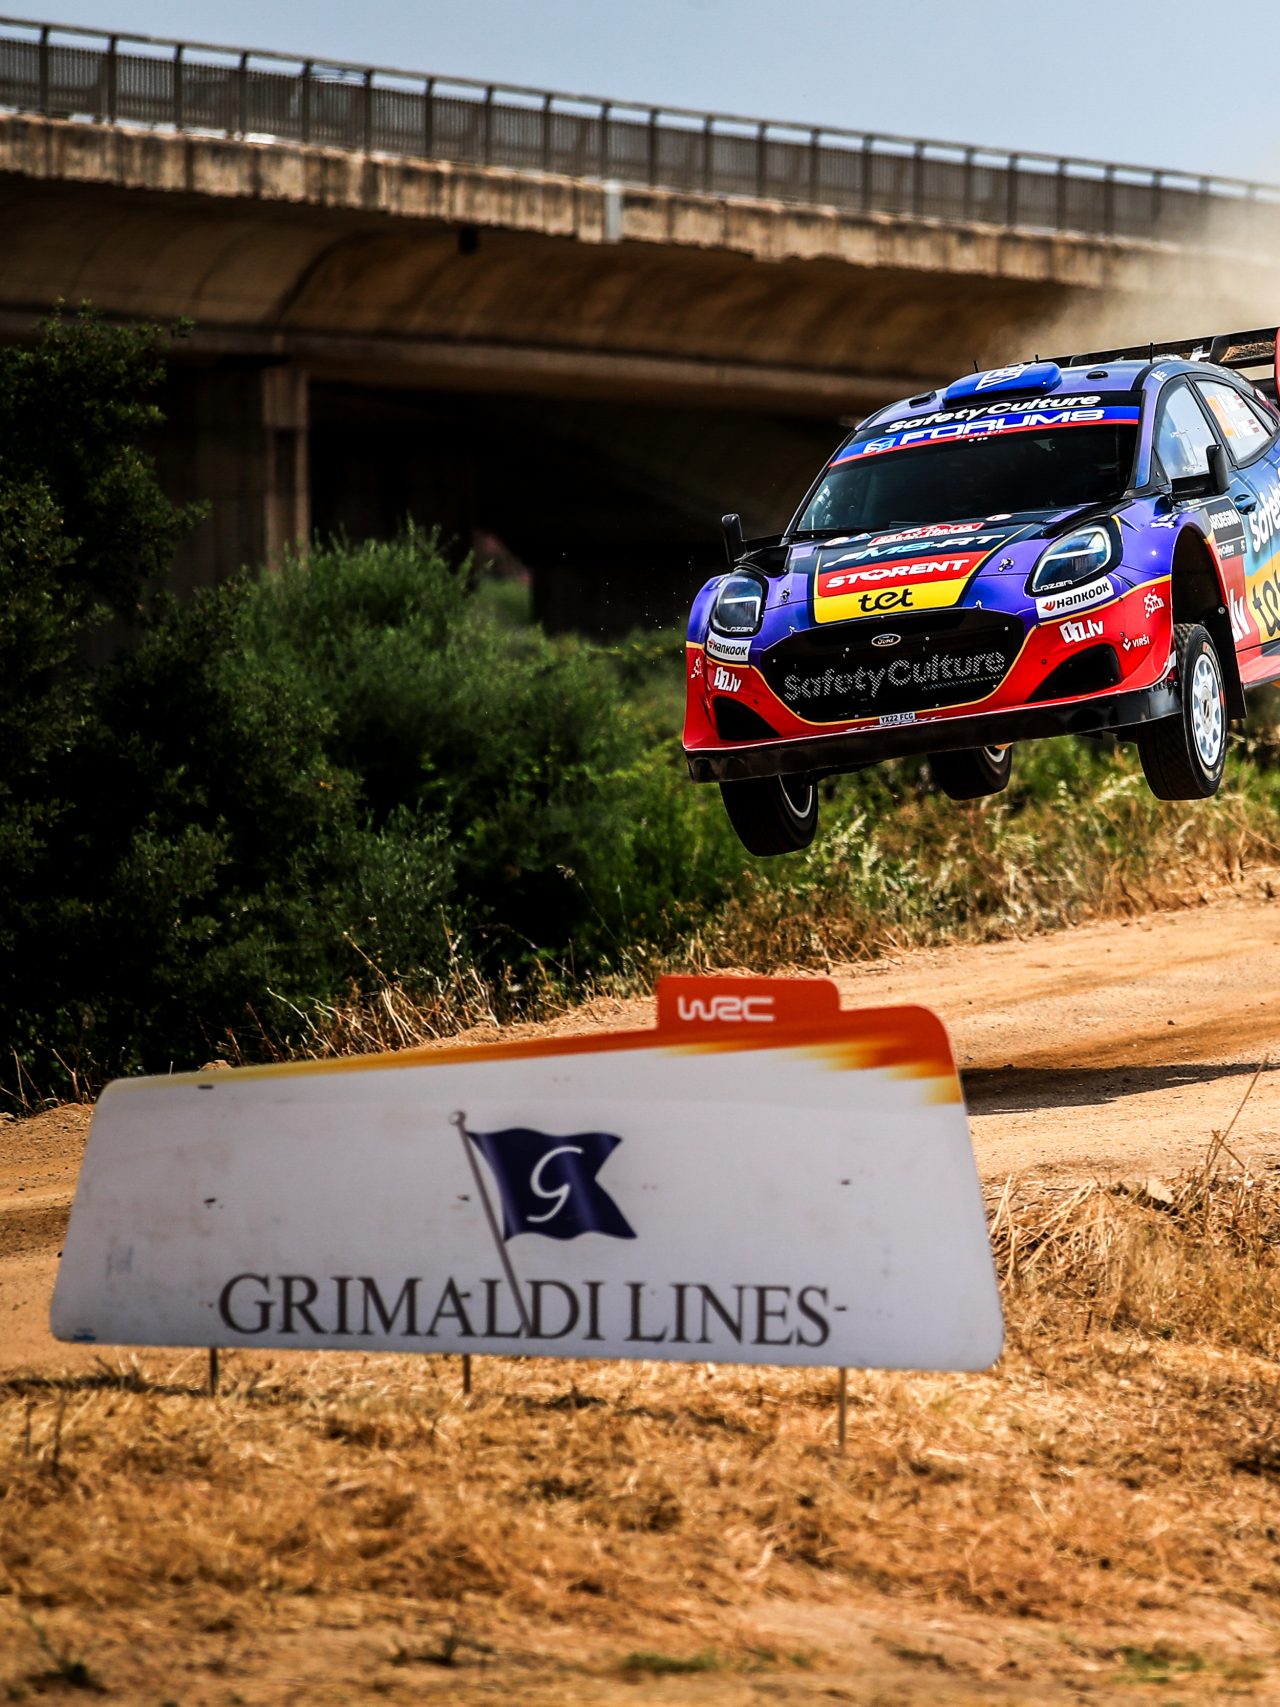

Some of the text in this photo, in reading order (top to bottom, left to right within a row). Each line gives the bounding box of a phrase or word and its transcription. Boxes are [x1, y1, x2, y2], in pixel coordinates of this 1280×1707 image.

[884, 394, 1101, 433] SafetyCulture
[899, 409, 1105, 445] FORUM8
[826, 559, 970, 588] STORENT
[858, 589, 914, 612] tet
[1059, 619, 1104, 643] 11.lv
[714, 667, 741, 692] 11.lv
[784, 652, 1005, 701] SafetyCulture
[880, 714, 898, 724] YX22
[899, 712, 914, 721] FCG
[677, 996, 775, 1022] WRC
[218, 1272, 832, 1347] GRIMALDI LINES
